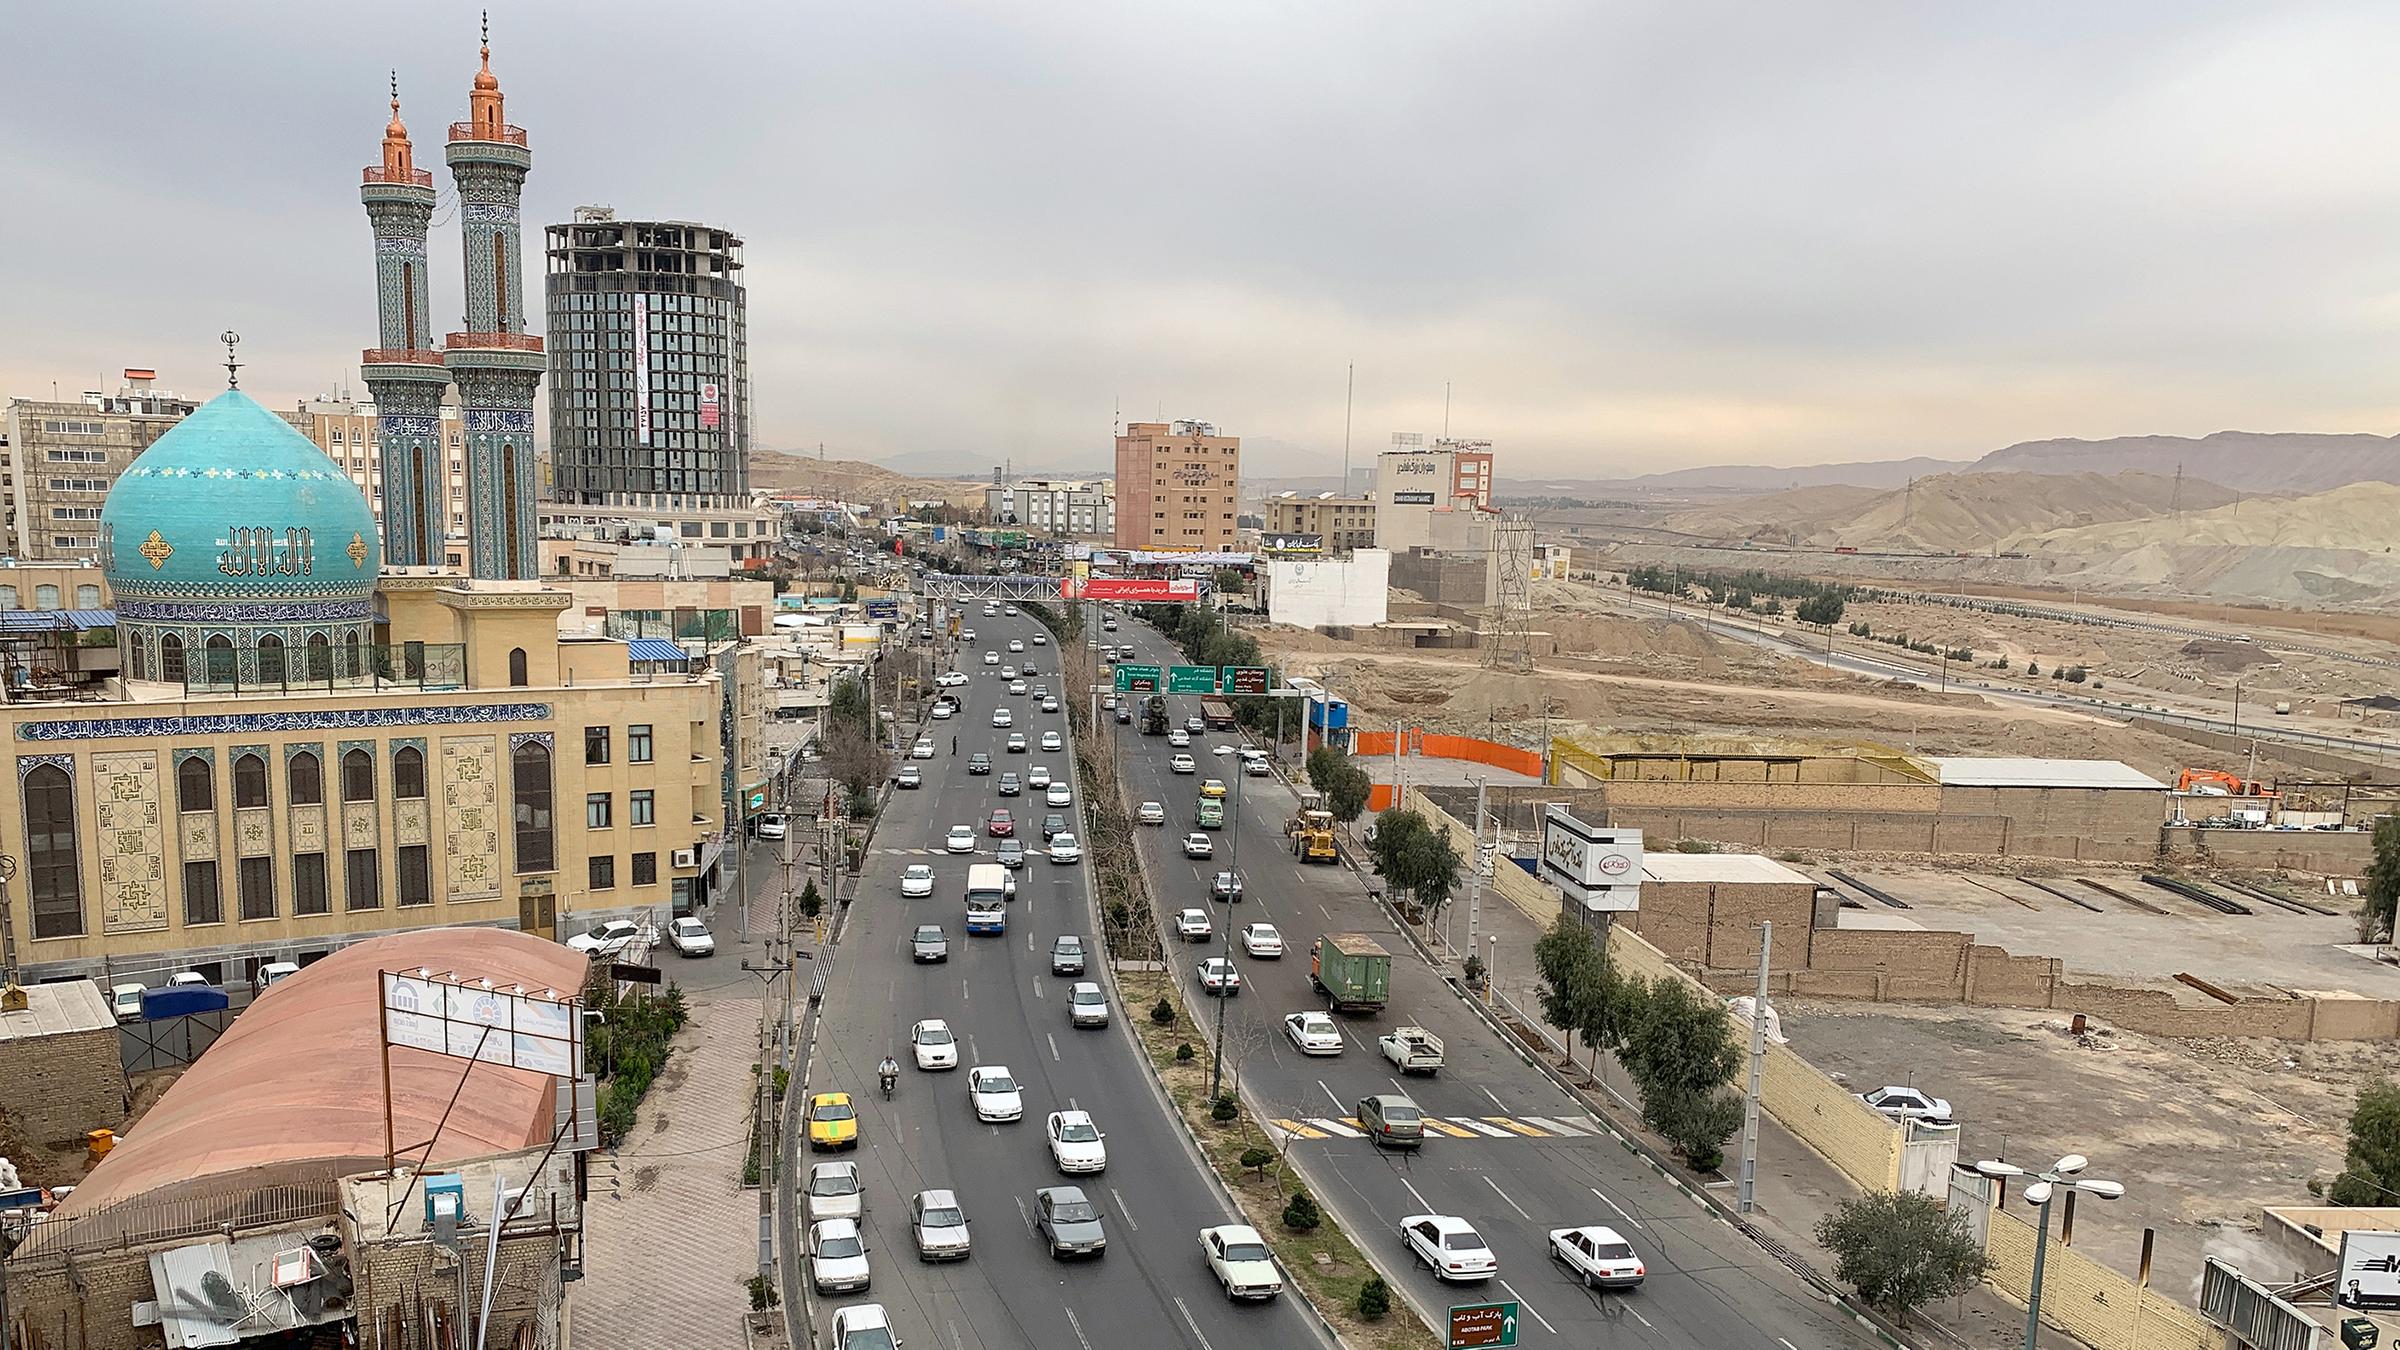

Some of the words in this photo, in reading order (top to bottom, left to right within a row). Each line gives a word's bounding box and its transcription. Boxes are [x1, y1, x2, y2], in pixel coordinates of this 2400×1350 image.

[1453, 1314, 1467, 1322] تاب
[1472, 1310, 1485, 1321] آب
[1485, 1310, 1502, 1320] پارک
